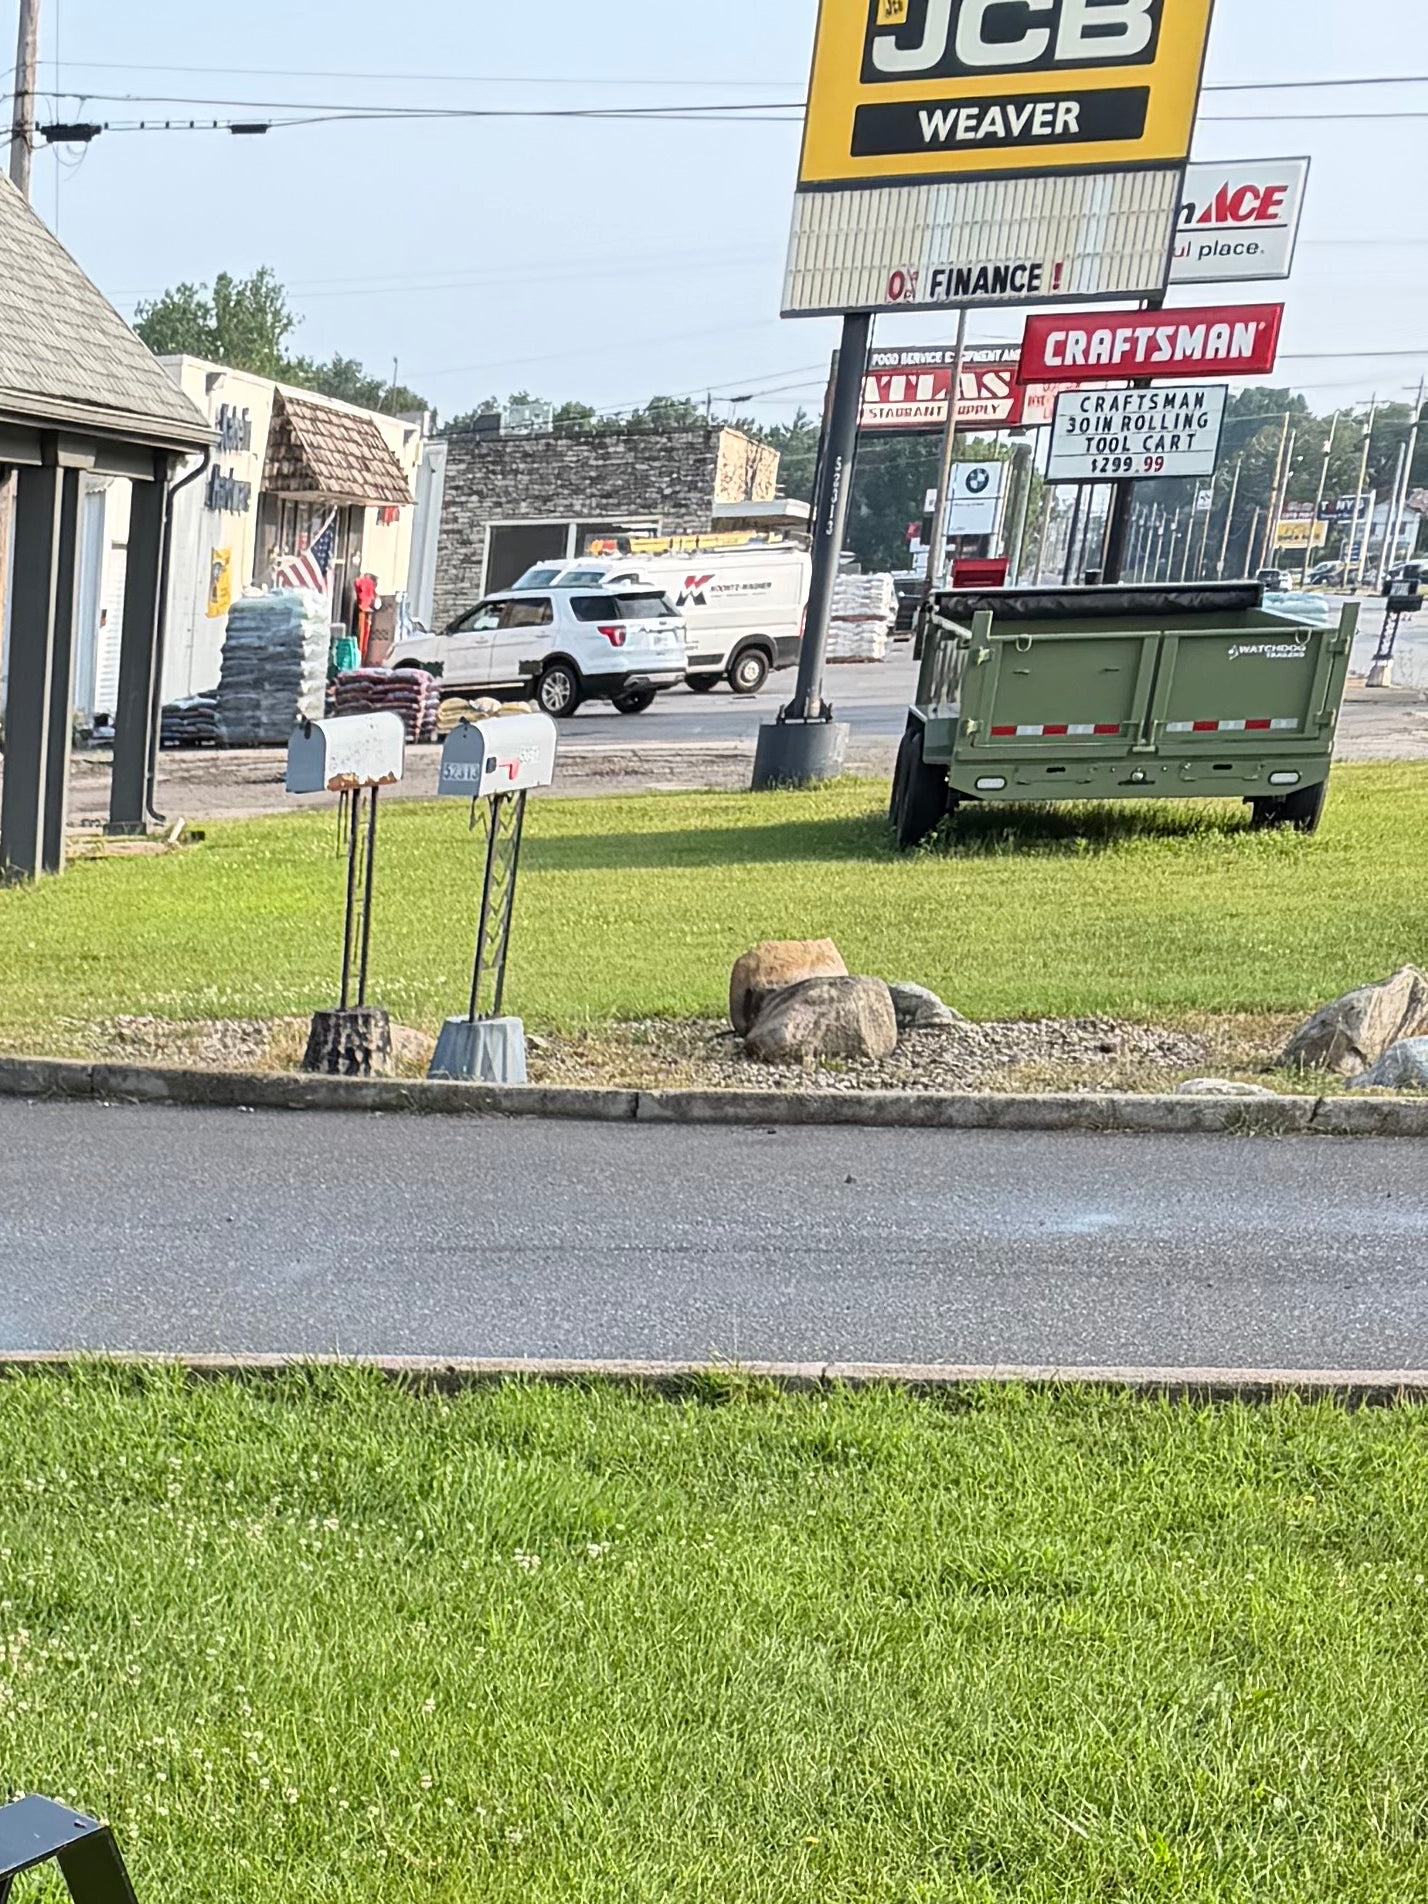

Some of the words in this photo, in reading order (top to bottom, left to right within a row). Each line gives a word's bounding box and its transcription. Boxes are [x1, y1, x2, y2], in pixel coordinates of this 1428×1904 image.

[872, 0, 1154, 72] JCB
[918, 101, 1081, 143] WEAVER
[1196, 180, 1289, 223] ACE
[1198, 240, 1265, 261] place.
[929, 263, 1044, 298] FINANCE
[1044, 321, 1260, 366] CRAFTSMAN
[872, 353, 899, 366] FOOD
[862, 372, 1011, 402] ATLAS
[957, 403, 1001, 416] UPPLY
[1080, 392, 1206, 413] CRAFTSMAN
[1121, 412, 1208, 431] ROLLING
[1085, 435, 1131, 453] TOOL
[1142, 432, 1197, 450] CART
[1091, 455, 1165, 475] $299.99
[1239, 643, 1306, 654] WATCHDOG
